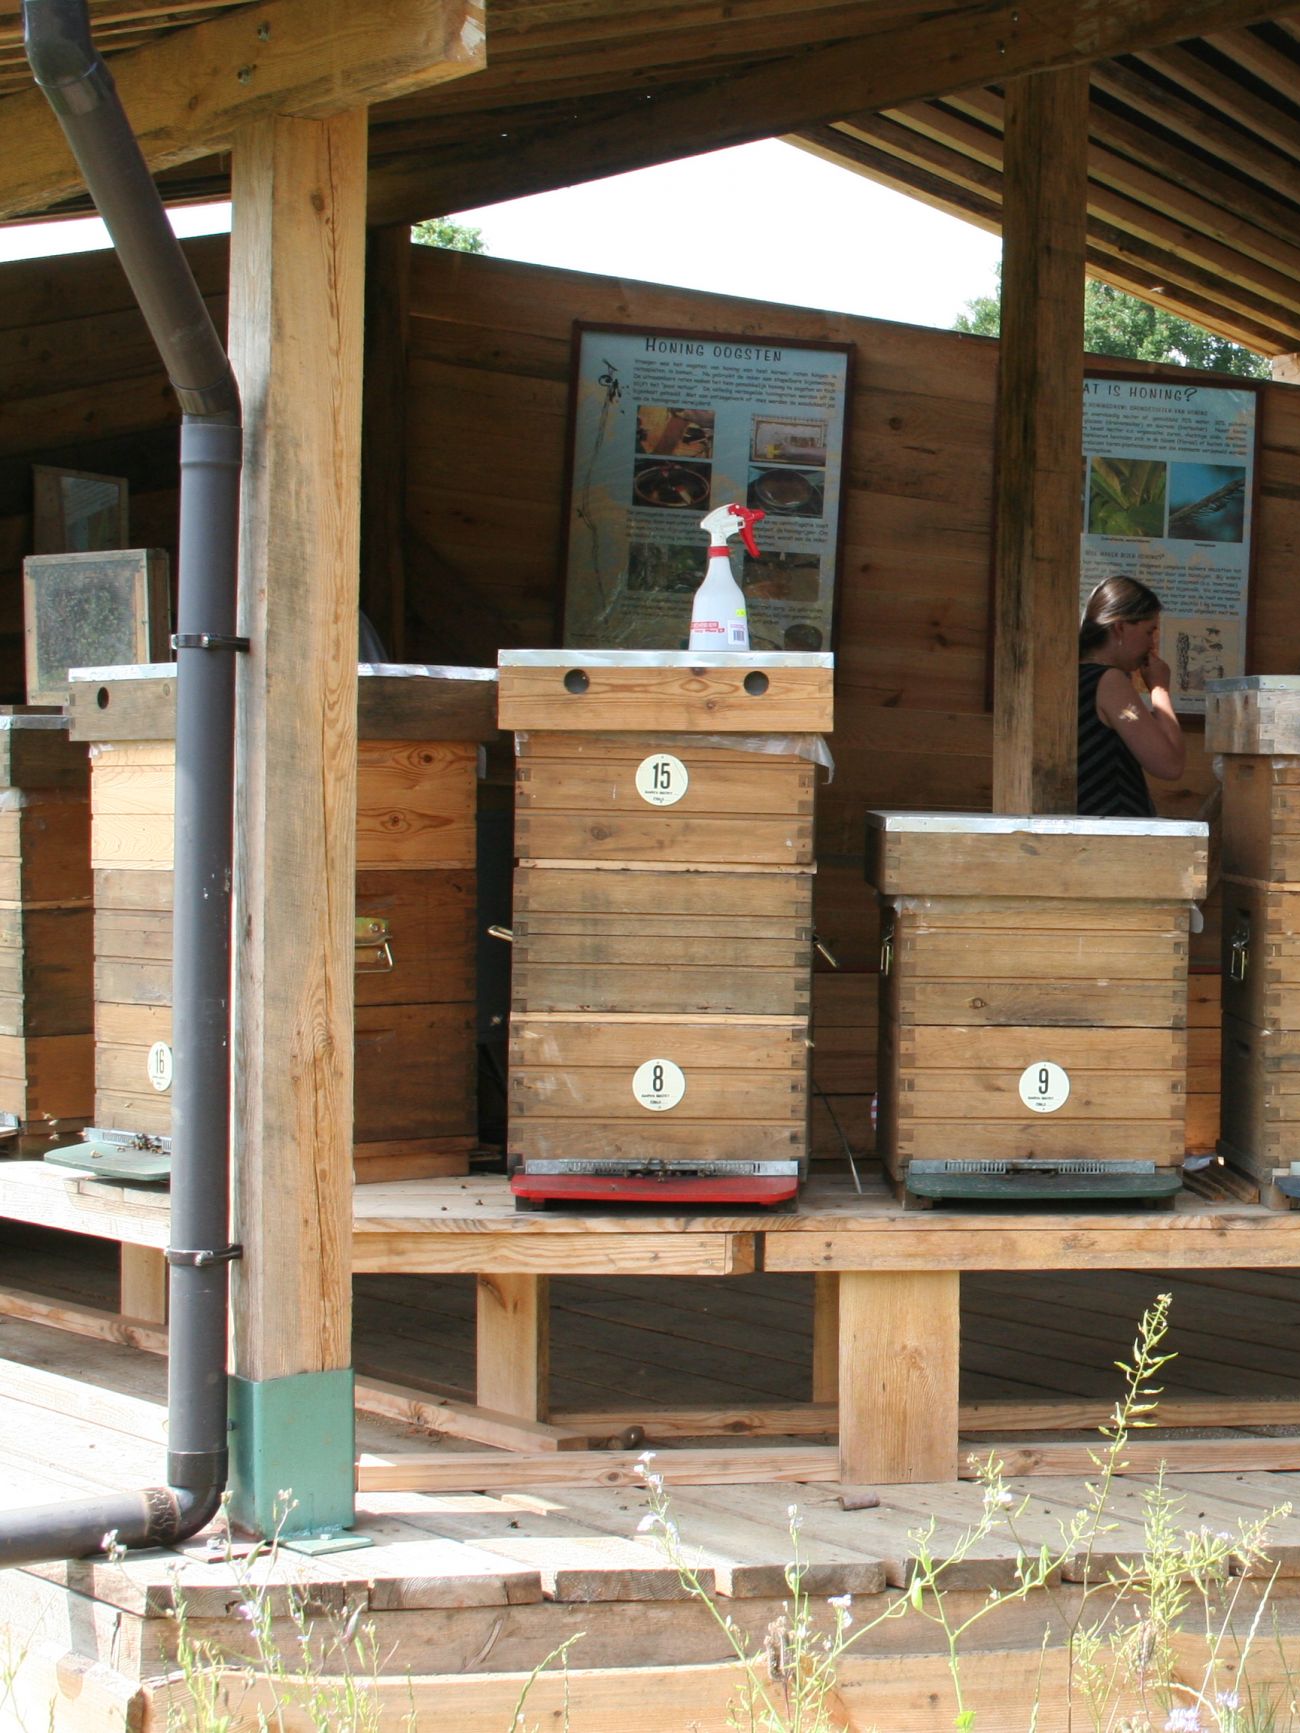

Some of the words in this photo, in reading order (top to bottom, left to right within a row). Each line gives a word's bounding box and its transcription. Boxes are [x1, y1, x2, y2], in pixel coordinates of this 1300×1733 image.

[645, 337, 704, 356] HONING
[713, 345, 782, 362] OOGSTEN
[1083, 383, 1100, 396] AT
[1108, 385, 1121, 397] IS
[1129, 386, 1198, 402] HONING?
[653, 762, 671, 789] 15
[155, 1048, 165, 1074] 16
[652, 1064, 664, 1092] 8
[1038, 1067, 1049, 1095] 9
